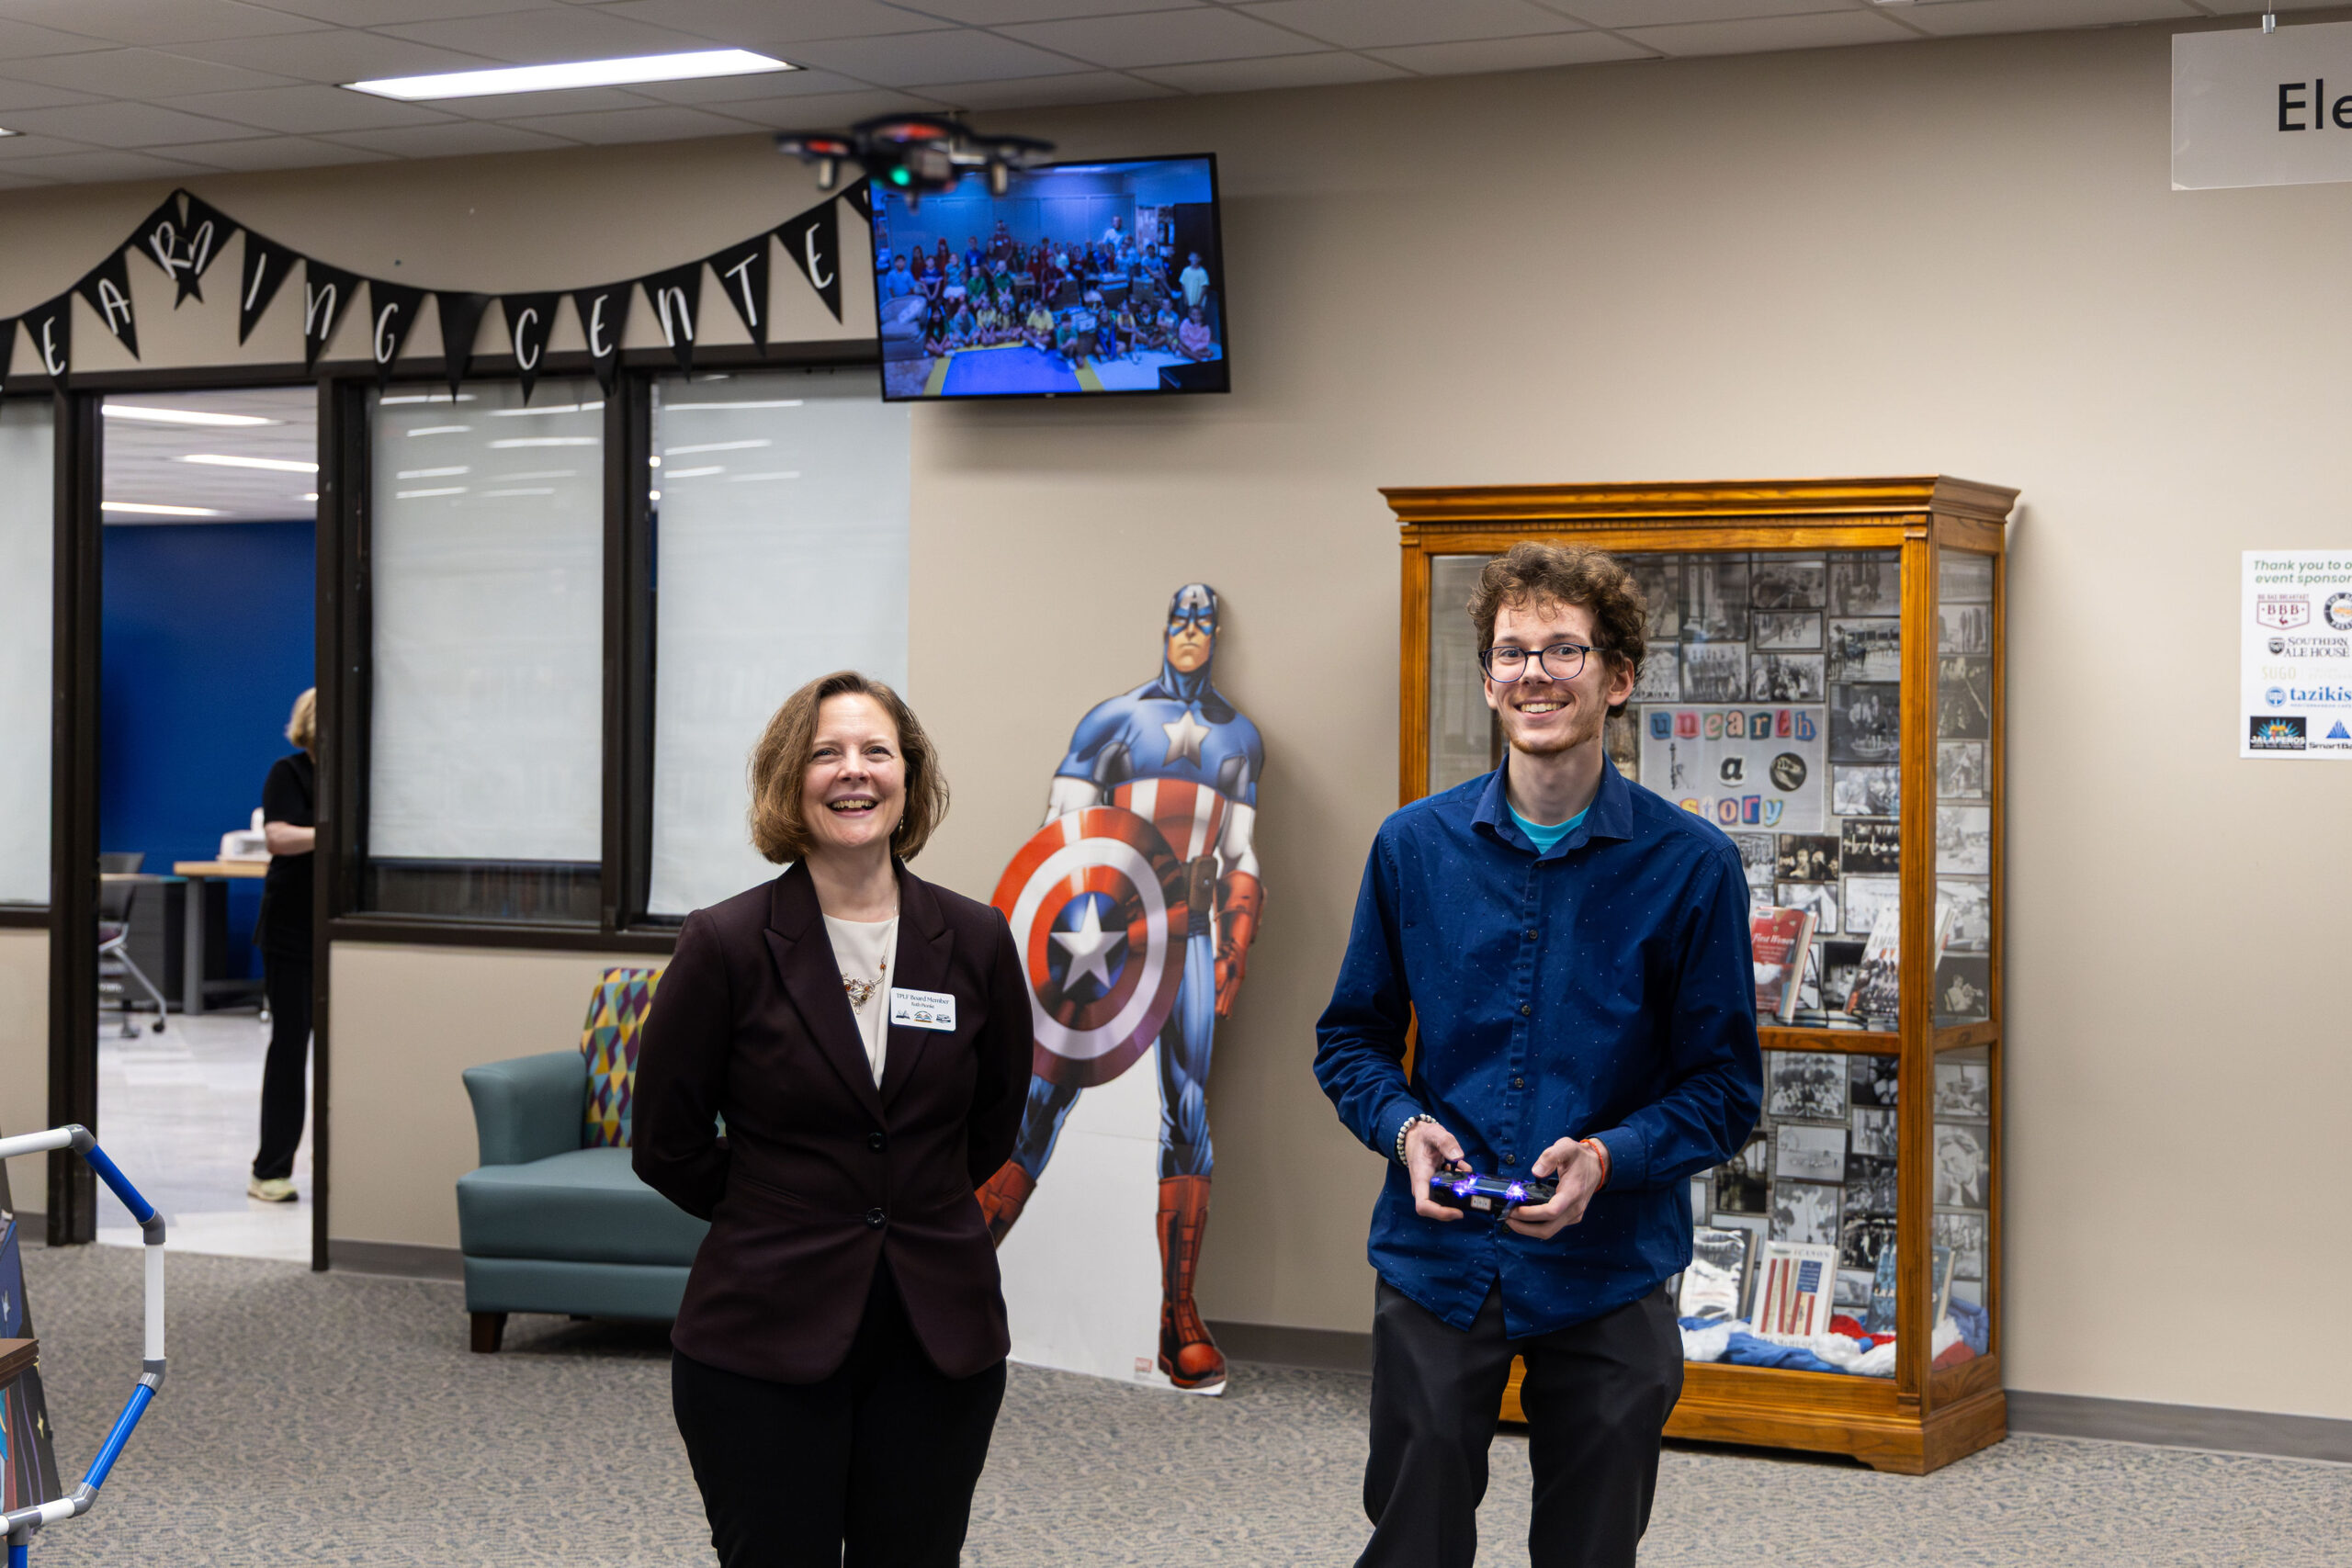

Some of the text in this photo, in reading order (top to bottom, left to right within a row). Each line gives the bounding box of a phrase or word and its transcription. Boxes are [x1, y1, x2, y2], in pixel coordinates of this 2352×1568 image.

[2278, 78, 2352, 131] Ele
[0, 189, 869, 392] EARNING CENTE
[2255, 559, 2295, 570] Thank
[2299, 561, 2324, 574] you
[2328, 560, 2342, 570] to
[2256, 574, 2352, 587] event sponsor
[2288, 637, 2348, 647] SOUTHERN
[2284, 647, 2350, 658] ALE HOUSE
[2262, 666, 2297, 681] SUGO
[2290, 686, 2352, 702] tazikis
[1651, 710, 1815, 739] unearth
[1720, 756, 1745, 782] a
[1680, 795, 1784, 827] story
[927, 997, 949, 1005] Member
